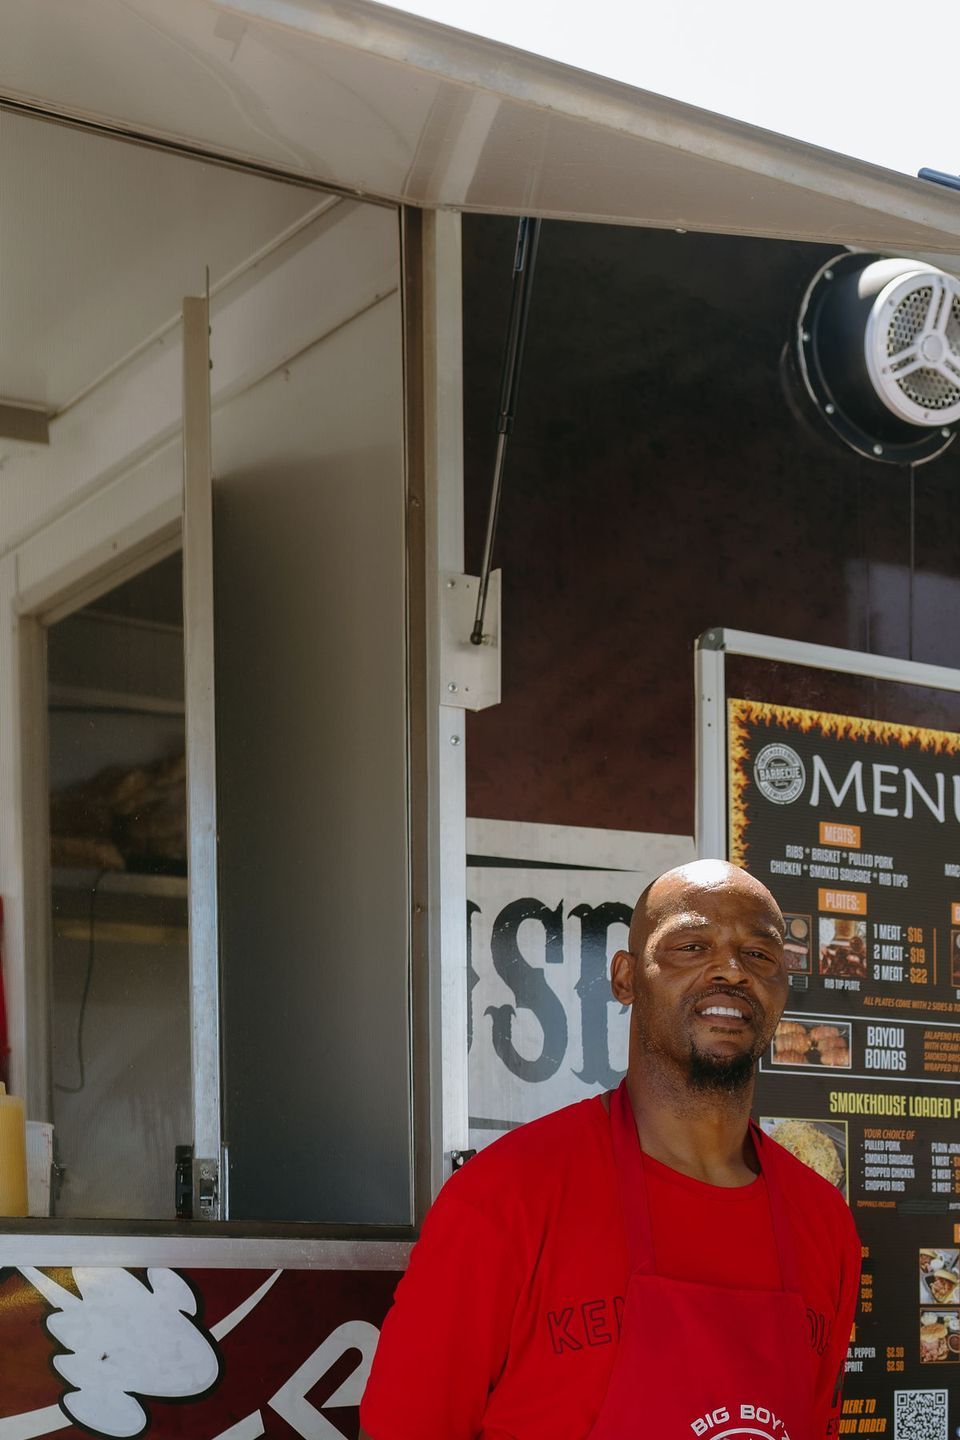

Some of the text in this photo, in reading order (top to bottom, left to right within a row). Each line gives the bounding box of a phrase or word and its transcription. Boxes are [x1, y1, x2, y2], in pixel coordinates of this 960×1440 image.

[759, 768, 802, 781] BARBECUE
[824, 826, 856, 844] MEATS:
[786, 845, 893, 869] RIBS BRISKET PULLED PORK
[770, 860, 908, 888] CHICKEN SMOKED SAUSAGE RIB TIPS
[826, 892, 860, 910] PLATES:
[879, 924, 923, 943] MEAT $16
[874, 944, 925, 963] 2 MEAT $19
[874, 965, 927, 984] 3 MEAT $22
[864, 996, 874, 1005] ALL
[875, 997, 895, 1007] PLATES
[895, 1000, 911, 1008] COME
[912, 1000, 927, 1009] WITH
[867, 1026, 904, 1048] BAYOU
[924, 1042, 939, 1050] WITH
[940, 1043, 959, 1051] CREAM
[865, 1049, 906, 1071] BOMBS
[924, 1052, 947, 1061] SMOKED
[924, 1063, 951, 1071] WRAPPED
[830, 1091, 906, 1117] SMOKEHOUSE
[909, 1095, 951, 1118] LOADED
[864, 1128, 915, 1139] YOUR CHOICE OF
[865, 1140, 900, 1151] PULLED PORK
[931, 1142, 947, 1153] PLAIN
[865, 1153, 887, 1164] SMOKED
[936, 1156, 949, 1166] MEAT
[865, 1167, 915, 1178] CHOPPED CHICKEN
[937, 1169, 951, 1179] MEAT
[865, 1180, 905, 1192] CHOPPED RIBS
[932, 1182, 936, 1193] 3
[937, 1182, 951, 1193] MEAT
[855, 1347, 875, 1358] PEPPER
[887, 1347, 904, 1358] $2.50
[887, 1361, 904, 1372] $2.50
[842, 1399, 876, 1414] HERE TO
[691, 1407, 730, 1436] BIG
[858, 1418, 887, 1433] ORDER
